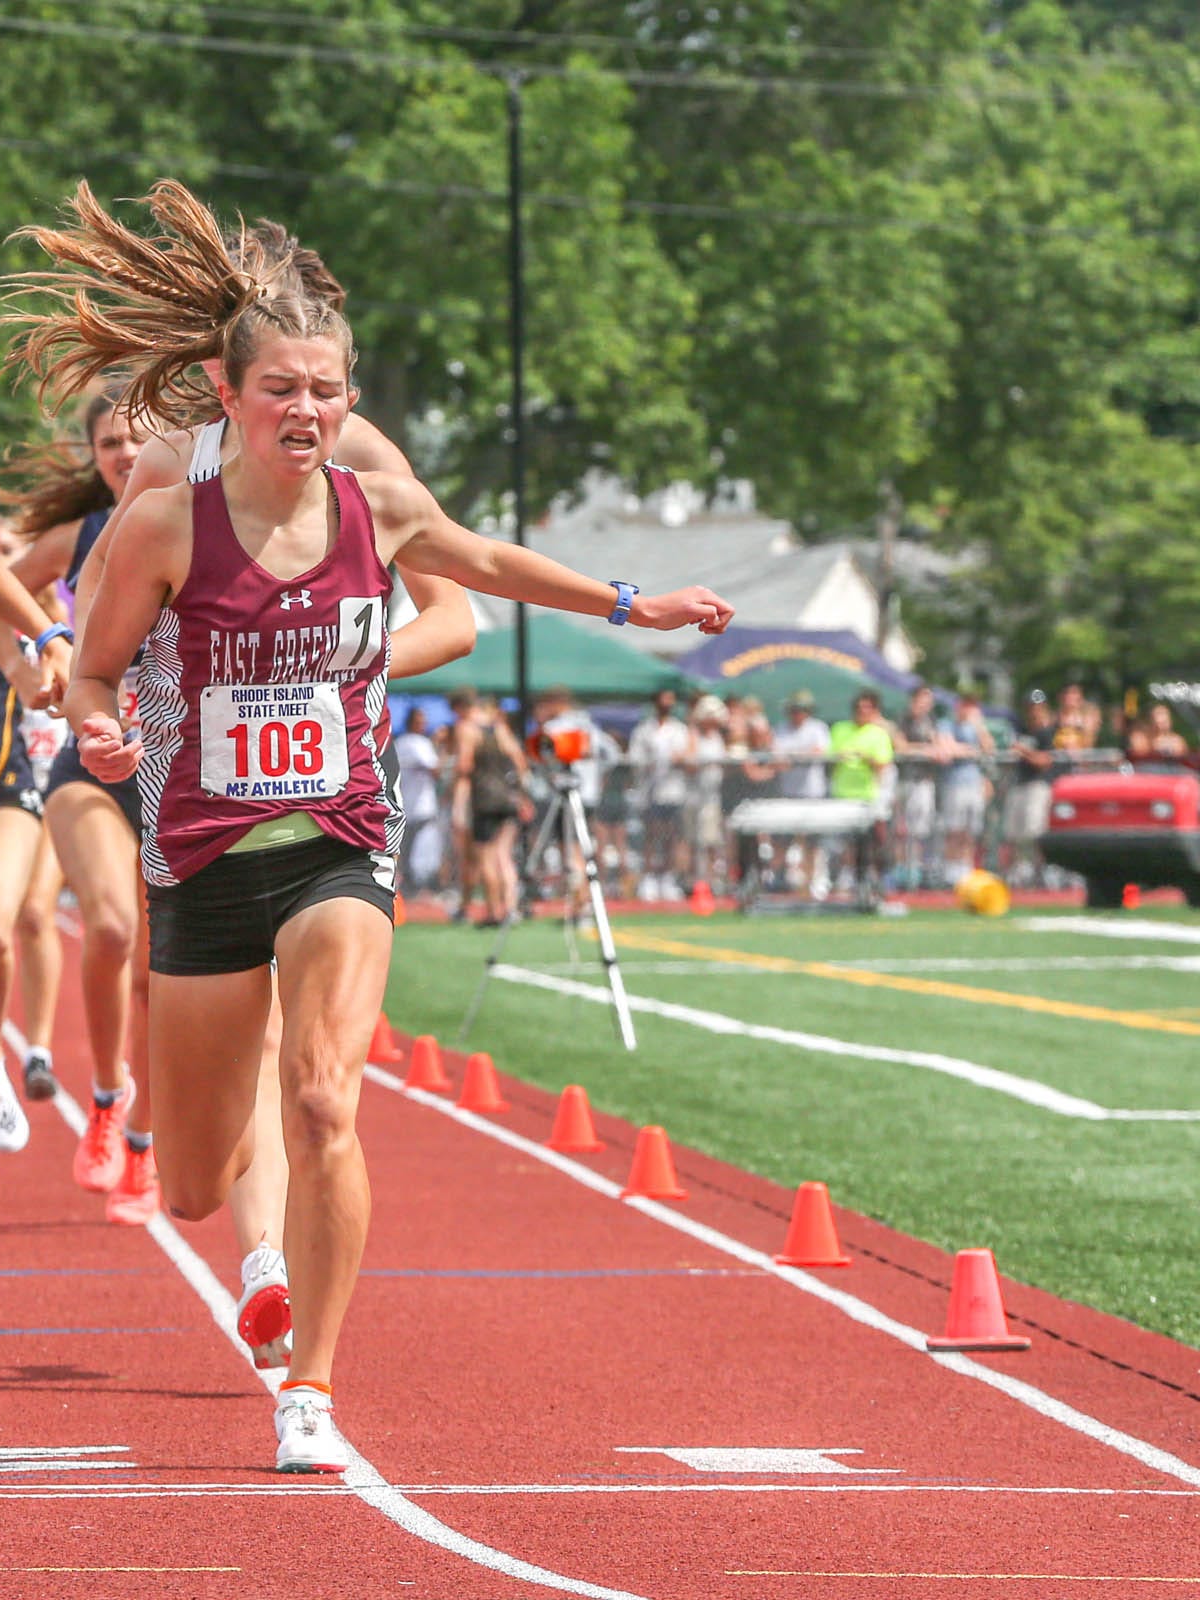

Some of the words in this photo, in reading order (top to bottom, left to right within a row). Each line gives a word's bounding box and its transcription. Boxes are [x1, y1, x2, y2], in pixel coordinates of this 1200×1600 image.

[348, 603, 373, 667] 1
[210, 630, 261, 685] EAST
[268, 625, 358, 683] GREEN
[232, 688, 271, 703] RHODE
[273, 686, 315, 702] ISLAND
[238, 704, 275, 719] STATE
[278, 702, 309, 717] MEET
[226, 719, 324, 778] 103
[225, 782, 249, 797] MF
[251, 778, 327, 796] ATHLETIC
